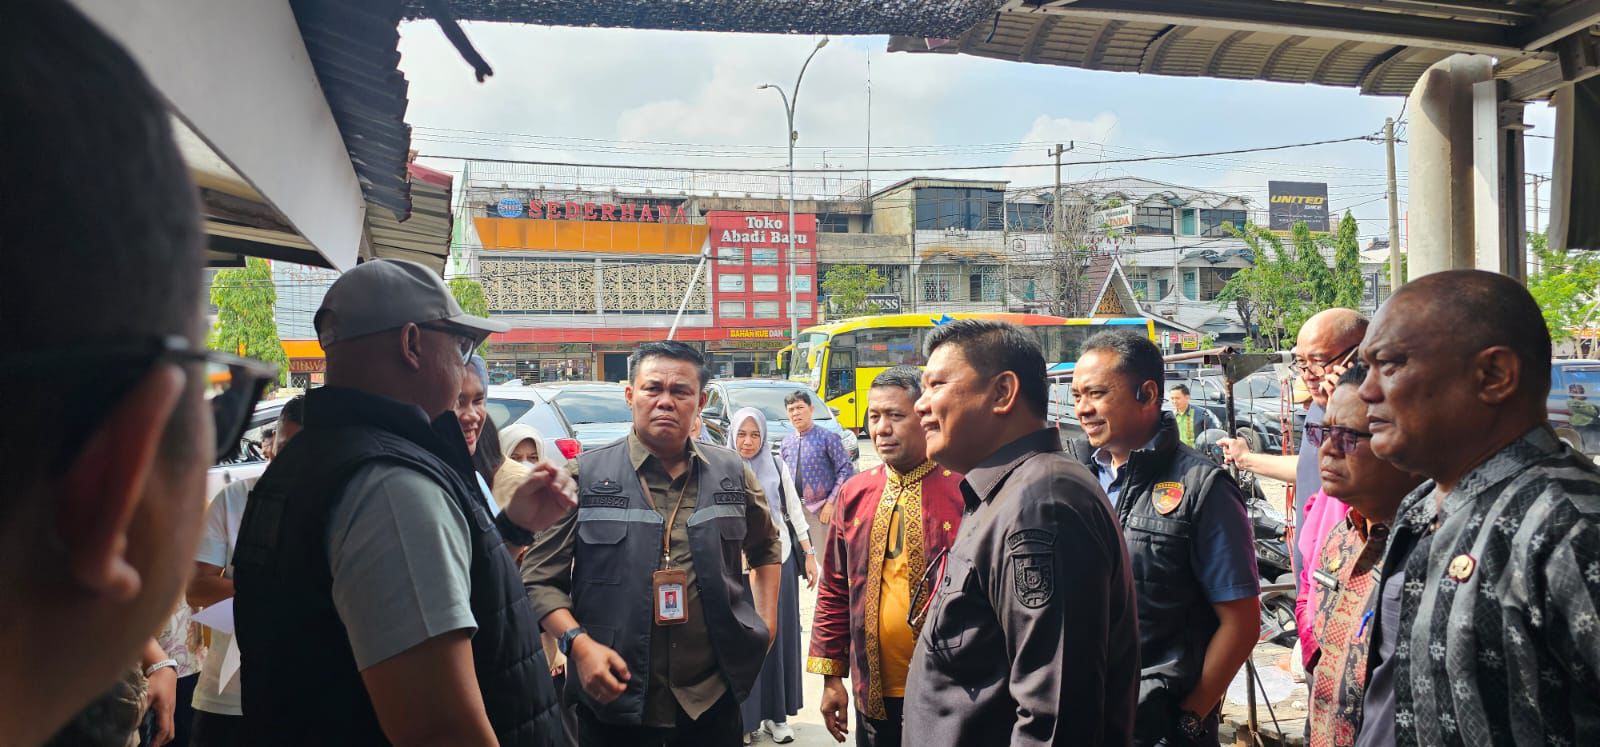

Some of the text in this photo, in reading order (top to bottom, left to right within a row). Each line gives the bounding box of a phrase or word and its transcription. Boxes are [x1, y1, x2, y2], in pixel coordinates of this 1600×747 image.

[1271, 195, 1324, 204] UNITED
[528, 199, 688, 224] SEDERHANA
[745, 216, 783, 229] Toko
[721, 230, 766, 243] Abadi
[730, 329, 754, 338] BAHAN
[755, 329, 769, 338] KUE
[769, 329, 783, 337] DAN
